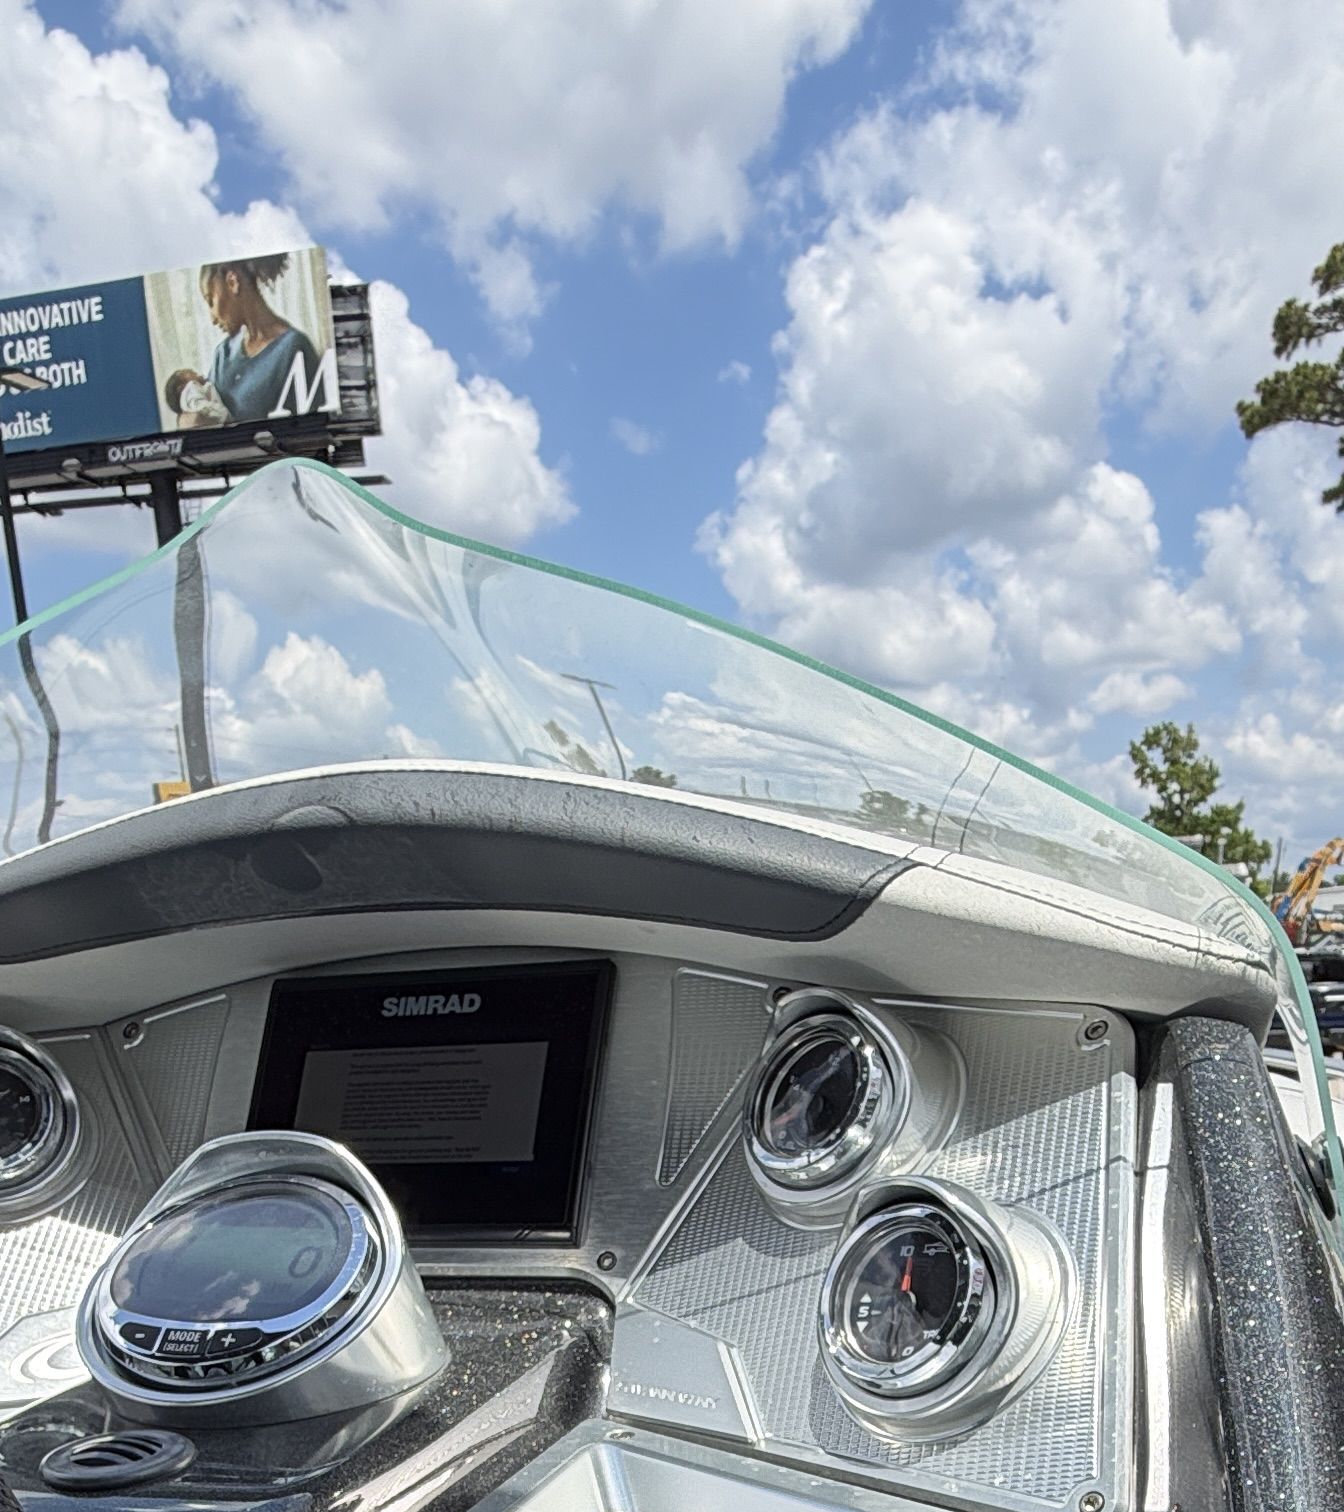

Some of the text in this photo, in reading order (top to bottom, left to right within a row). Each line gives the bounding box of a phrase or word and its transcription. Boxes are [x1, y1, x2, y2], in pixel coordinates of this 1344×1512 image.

[3, 336, 52, 366] CARE
[268, 349, 342, 419] M
[382, 993, 481, 1017] SIMRAD
[900, 1245, 915, 1256] 10
[168, 1331, 202, 1342] MODE
